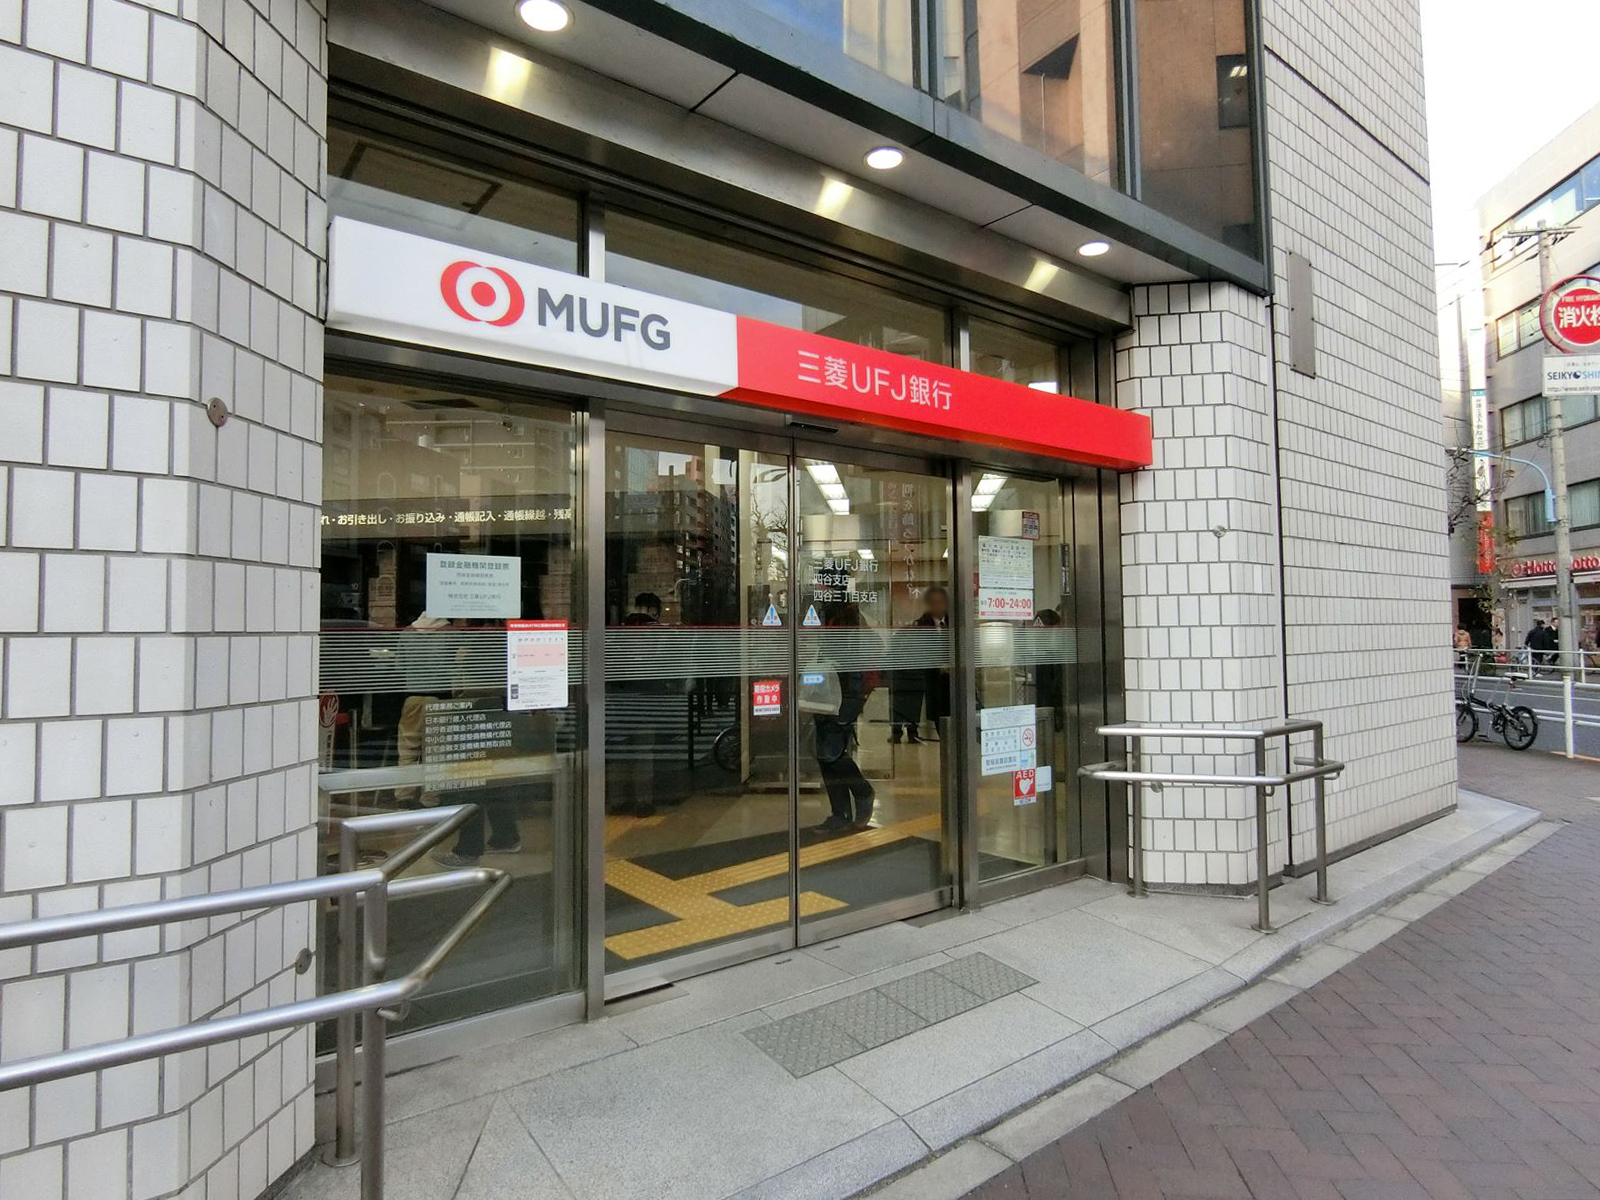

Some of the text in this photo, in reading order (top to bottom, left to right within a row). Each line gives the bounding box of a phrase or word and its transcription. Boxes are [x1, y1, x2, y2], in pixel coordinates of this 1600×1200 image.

[537, 286, 672, 352] MUFG
[797, 350, 954, 412] 三菱UFJ銀行
[814, 558, 878, 572] 三菱UFJ銀行
[814, 574, 850, 586] 四谷支店
[814, 590, 878, 603] 四谷三丁目支店
[1016, 770, 1034, 779] AED
